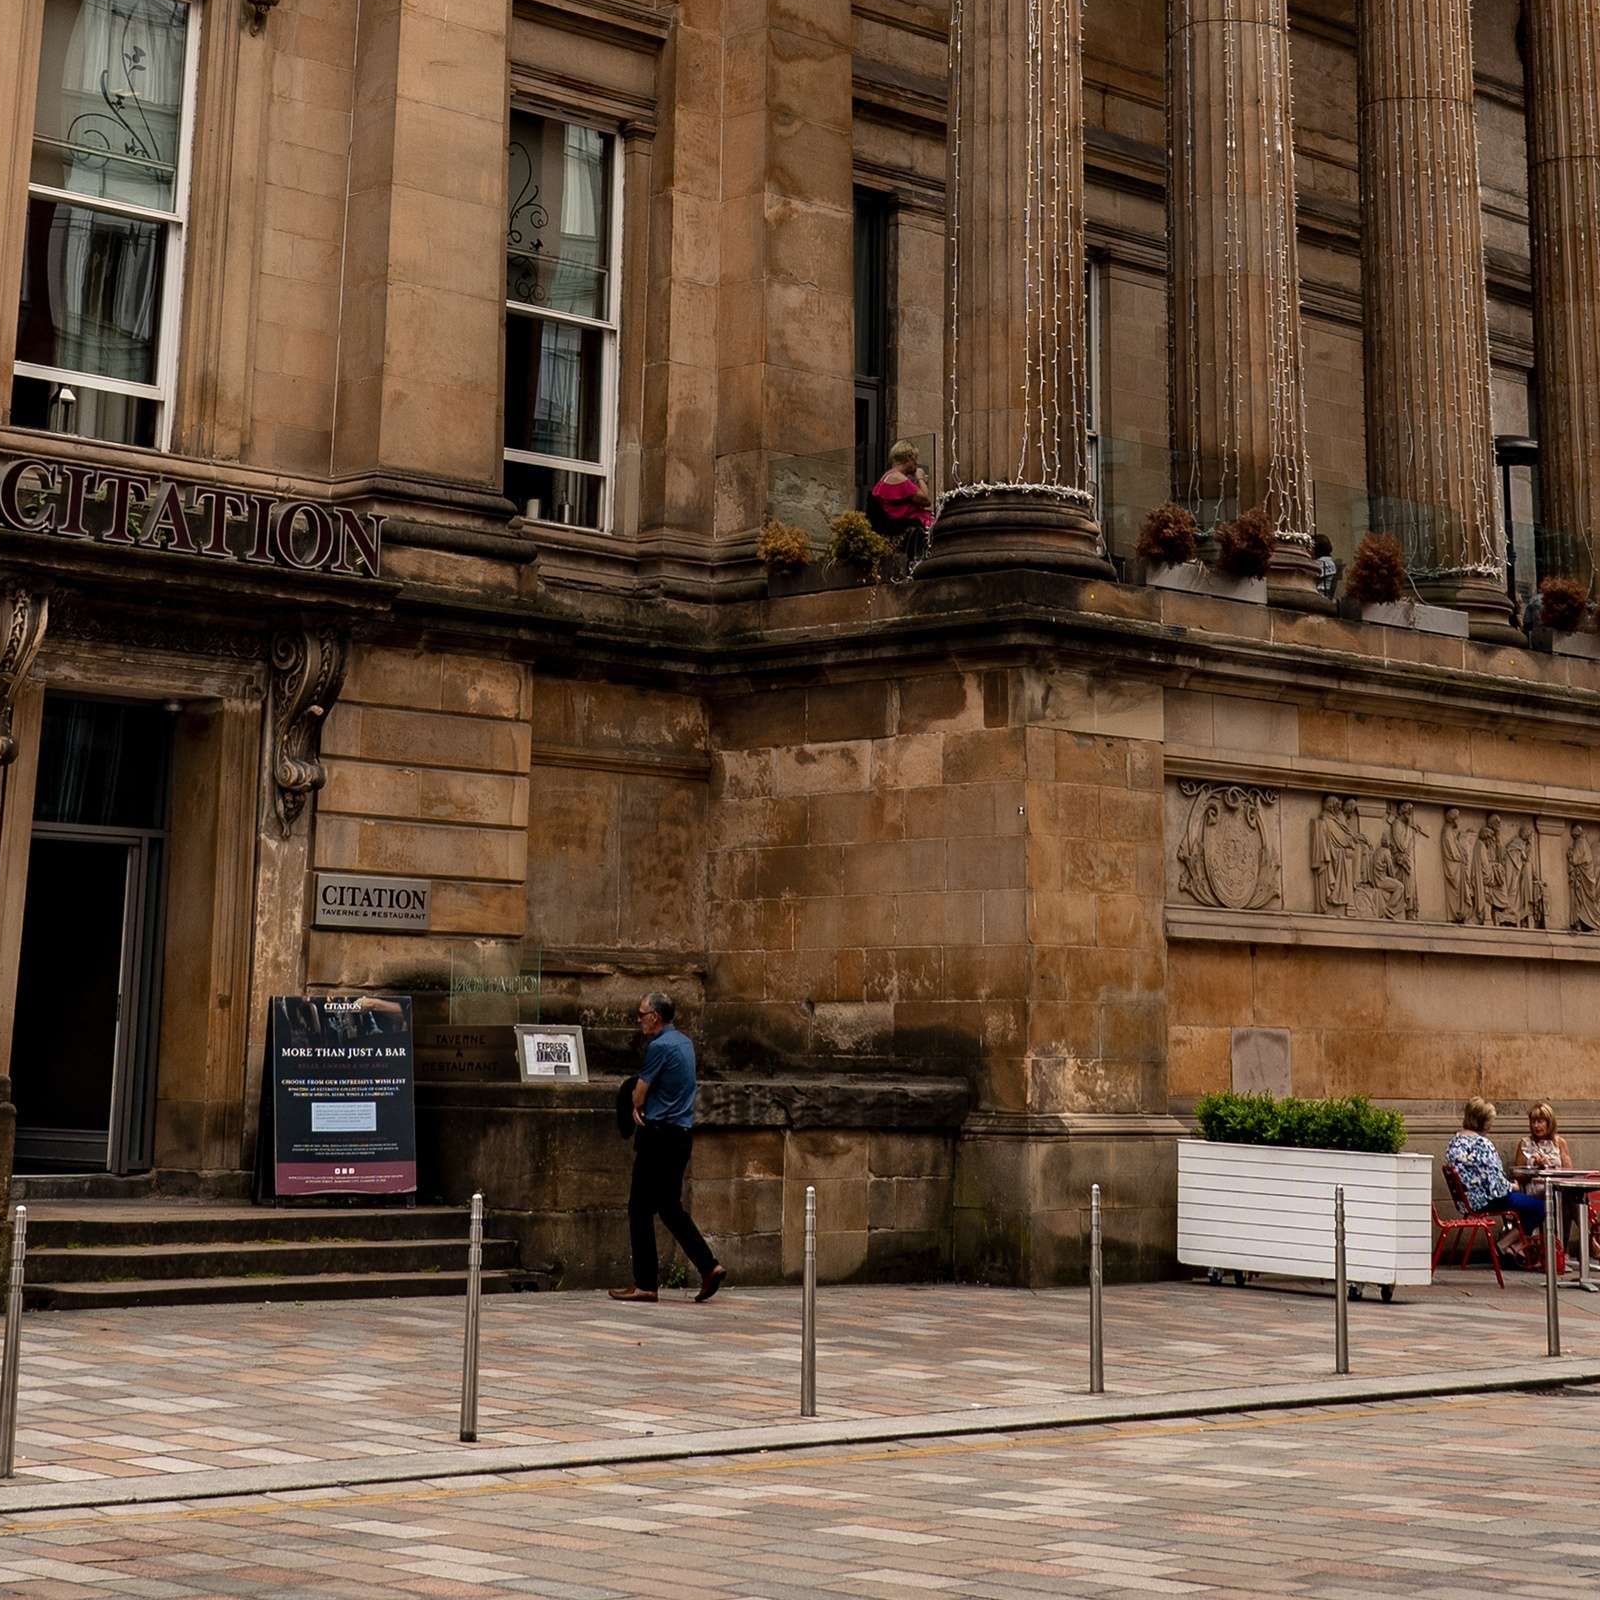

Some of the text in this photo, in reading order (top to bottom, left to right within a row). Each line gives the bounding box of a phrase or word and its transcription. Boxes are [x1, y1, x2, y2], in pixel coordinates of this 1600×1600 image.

[321, 885, 427, 910] CITATION
[321, 908, 359, 917] TAVERNE
[371, 911, 426, 920] RESTAURANT
[281, 1047, 407, 1059] MORE THAN JUST A BAR
[536, 1042, 569, 1052] EXPRESS
